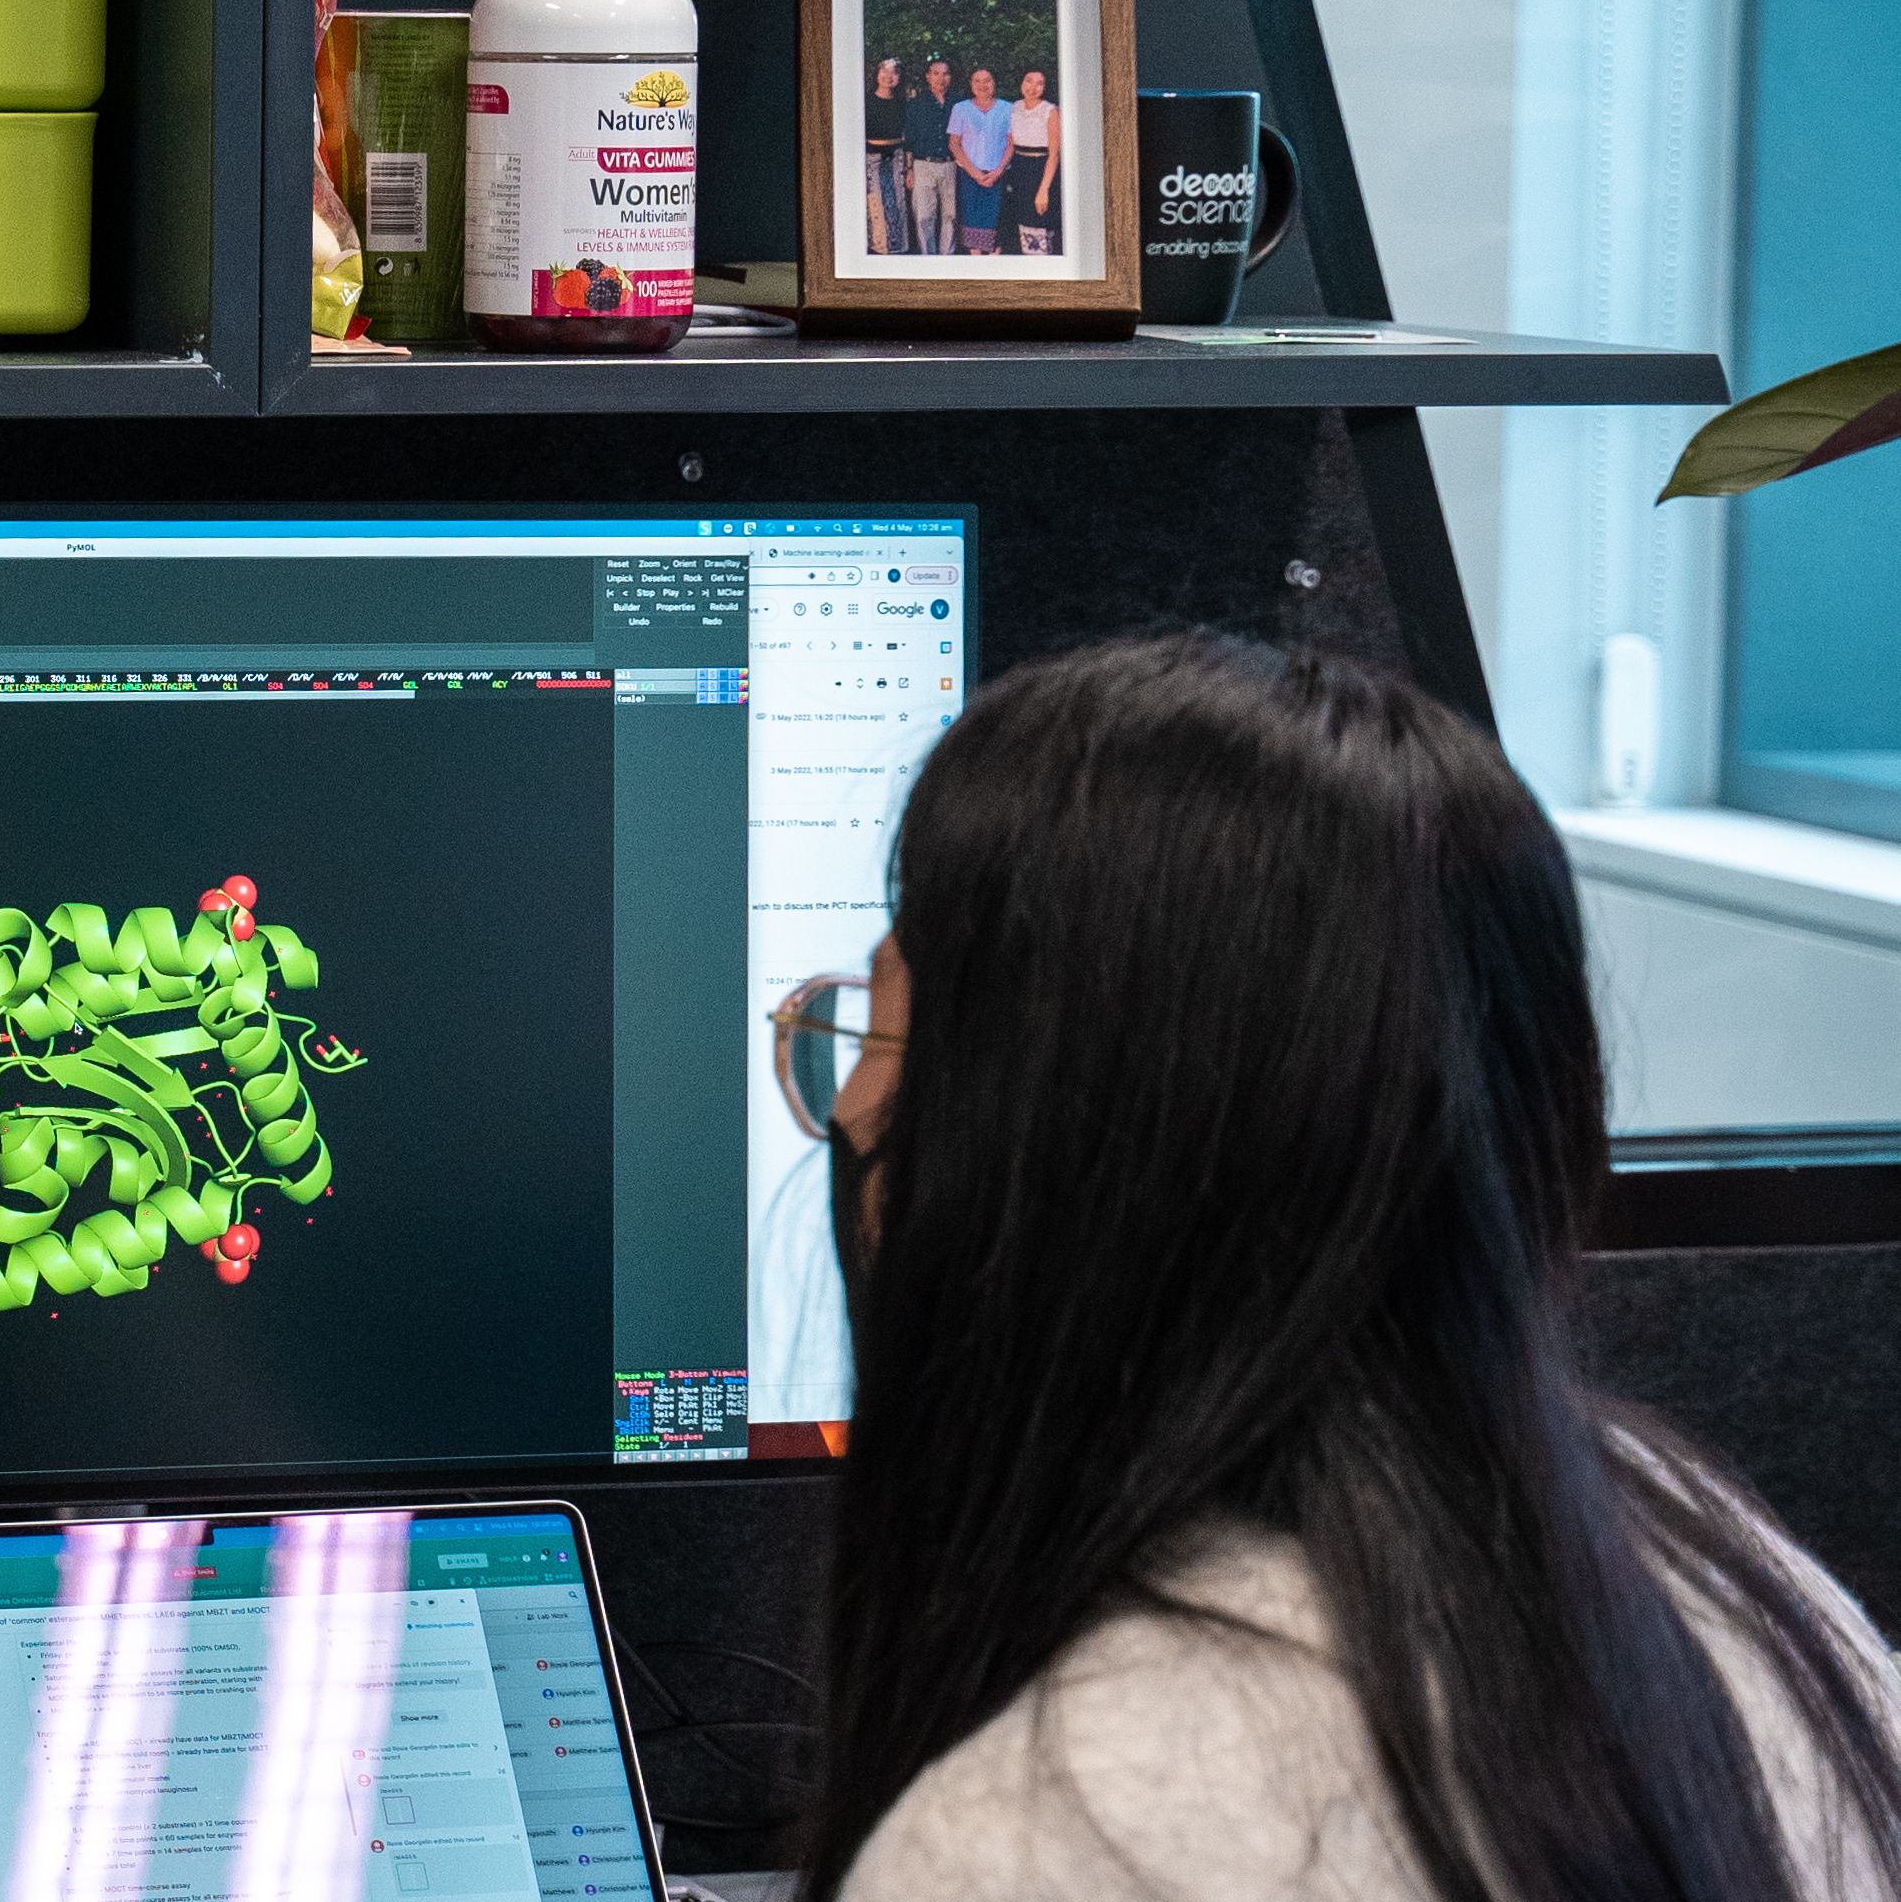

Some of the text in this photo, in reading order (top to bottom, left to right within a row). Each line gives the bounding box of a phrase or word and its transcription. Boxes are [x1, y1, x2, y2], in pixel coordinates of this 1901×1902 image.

[598, 109, 675, 131] Nature's
[568, 149, 595, 159] Adult
[603, 150, 694, 168] VITA GUMMIES
[620, 209, 687, 223] Multivitamin
[598, 229, 637, 239] HEALTH
[640, 229, 646, 238] &
[577, 243, 614, 252] LEVELS
[616, 243, 623, 252] &
[626, 241, 665, 252] IMMUNE
[637, 280, 657, 298] 100
[67, 544, 96, 552] PyMOL
[814, 549, 863, 558] learning-aided
[607, 560, 629, 568] Reset
[638, 560, 660, 568] Zoom
[607, 575, 634, 583] Unpick
[683, 574, 702, 582] Rock
[710, 574, 724, 582] Get
[913, 572, 940, 580] Update
[637, 589, 656, 598] Stop
[663, 589, 679, 597] Play
[656, 603, 696, 611] Properties
[710, 603, 738, 611] Rebuild
[876, 601, 925, 618] Google
[629, 617, 722, 626] Undo Redo
[752, 901, 847, 911] wish to discuss the PCT
[0, 1617, 8, 1625] of
[176, 1609, 204, 1618] against
[206, 1607, 229, 1616] MBZT
[230, 1607, 244, 1615] and
[245, 1605, 271, 1614] MOCT
